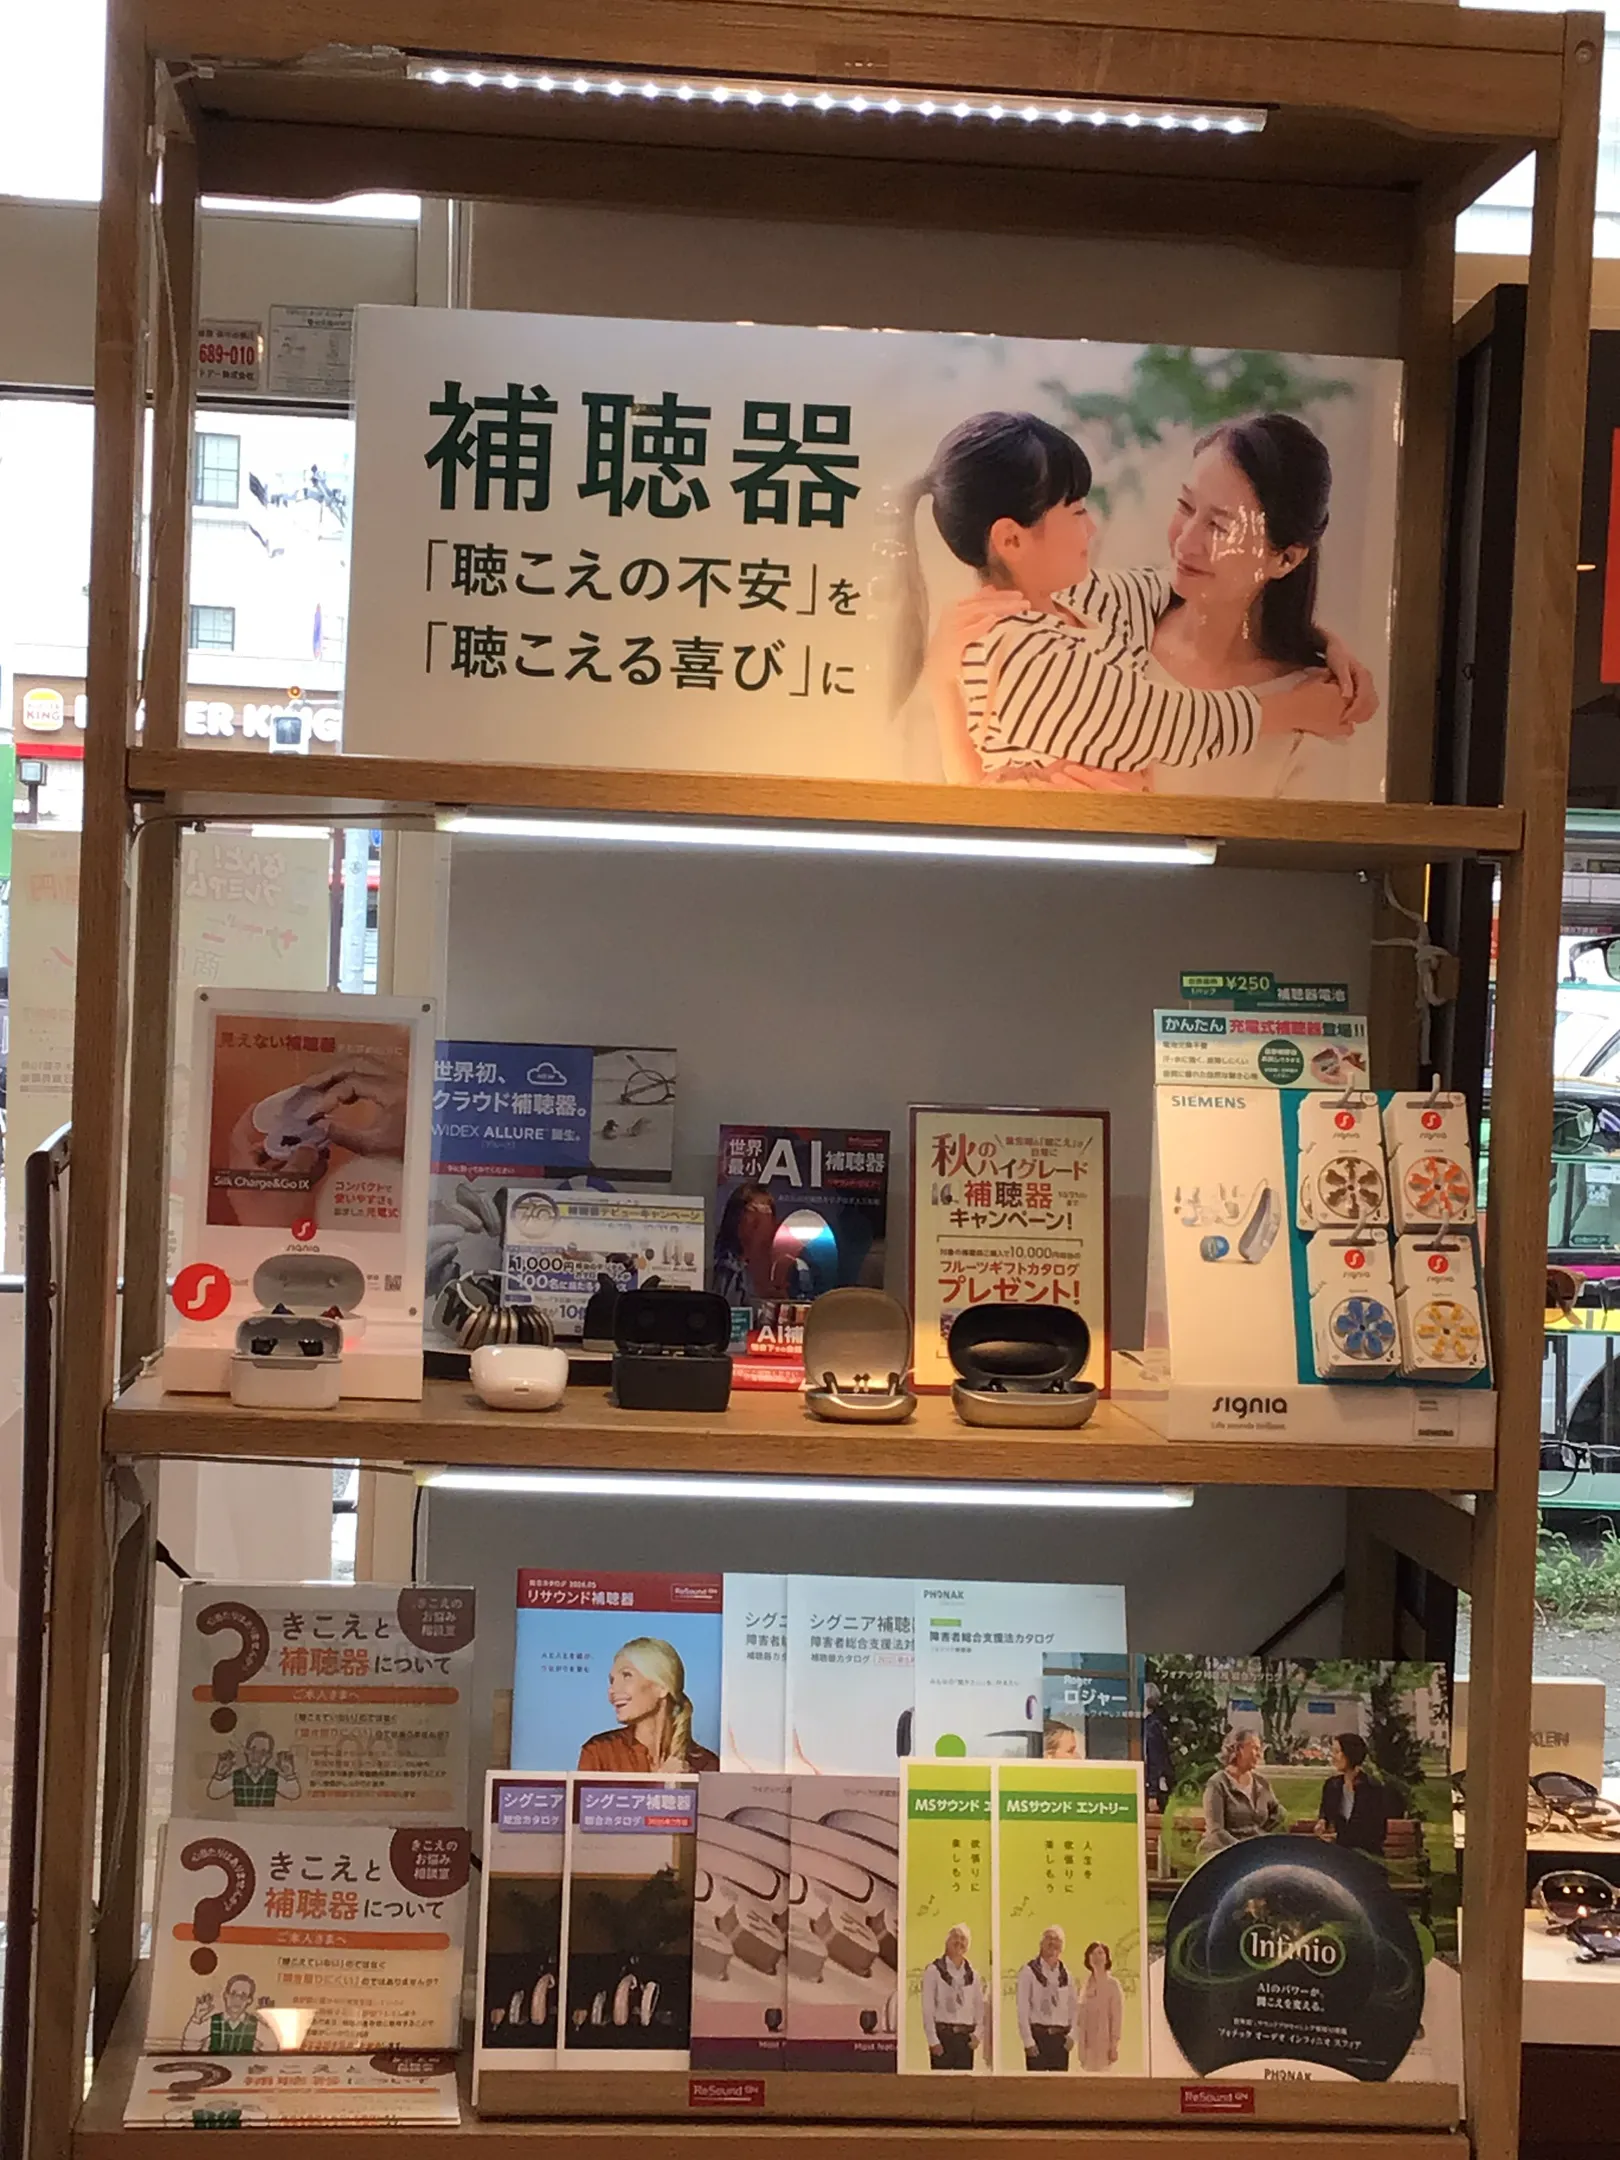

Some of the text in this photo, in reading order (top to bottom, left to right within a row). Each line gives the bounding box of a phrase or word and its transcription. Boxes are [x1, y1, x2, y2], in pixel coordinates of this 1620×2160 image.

[424, 380, 861, 528] 補聴器
[426, 539, 861, 616] 「聴こえの不安」を
[425, 620, 855, 697] 「聴こえる喜び」に
[243, 703, 342, 741] KG
[1226, 976, 1270, 990] ¥250
[1165, 1018, 1225, 1033] かんたん
[435, 1060, 506, 1084] 世界初、
[433, 1091, 587, 1117] クラウド補聴器。
[1171, 1095, 1246, 1109] SIEMENS
[484, 1128, 545, 1140] ALLURE
[729, 1138, 762, 1155] 世界
[931, 1133, 997, 1177] 秋の
[728, 1160, 761, 1176] 最小
[758, 1139, 885, 1187] AI 補聴器
[977, 1158, 1088, 1181] ハイグレード
[964, 1180, 1053, 1209] 補聴器
[950, 1208, 1072, 1230] キャンペーン!
[940, 1260, 1080, 1276] フルーツギフトカタログ
[938, 1275, 1080, 1305] プレゼント!
[1212, 1397, 1288, 1418] signia
[528, 1590, 634, 1606] リサウンド補聴器
[924, 1590, 964, 1600] PHONAK
[283, 1612, 390, 1640] きこえと
[809, 1614, 915, 1633] シグニア補聴
[280, 1647, 452, 1676] 補聴器について
[1064, 1689, 1127, 1706] ロジャー
[504, 1793, 563, 1809] シグニア
[586, 1794, 691, 1811] シグニア補聴器
[915, 1798, 979, 1812] MSサウンド
[1007, 1799, 1129, 1814] MSサウンド エントリー
[270, 1851, 382, 1882] きこえと
[264, 1887, 444, 1920] 補聴器について
[694, 2085, 742, 2097] ReSound
[1185, 2091, 1233, 2103] ReSound
